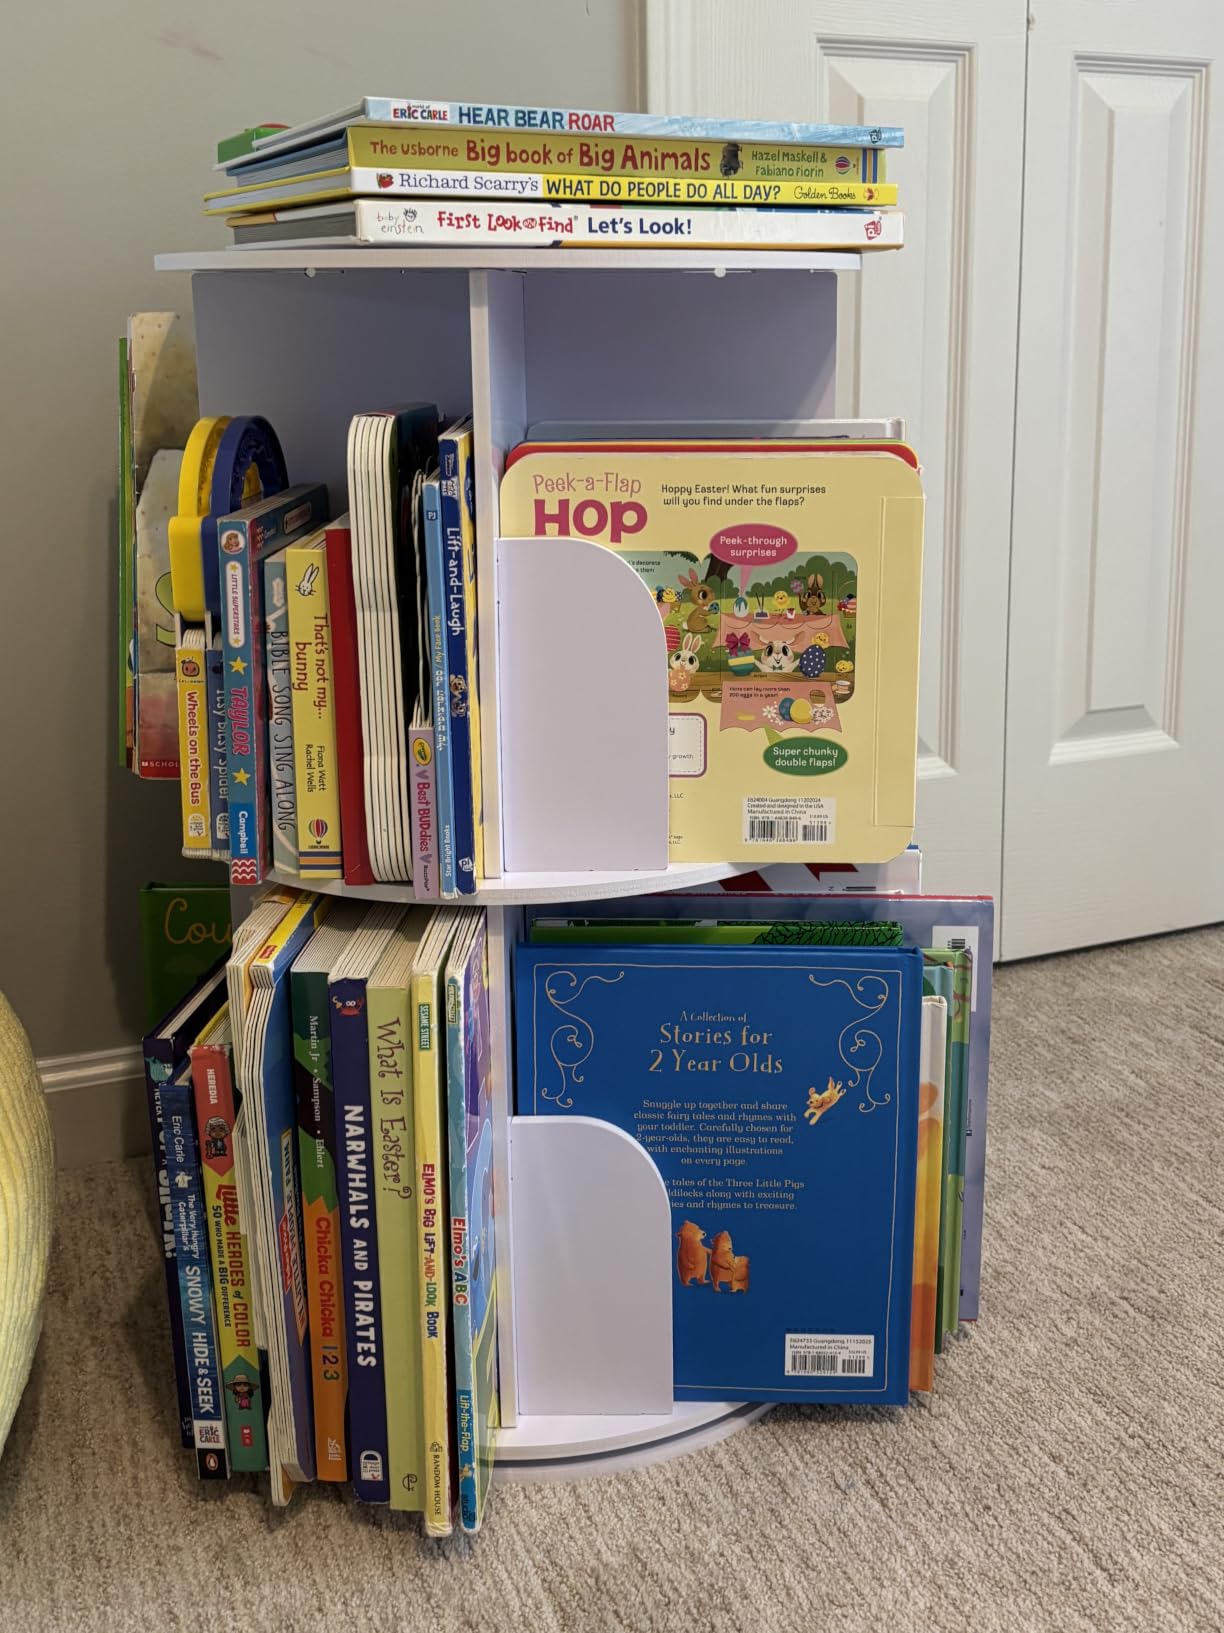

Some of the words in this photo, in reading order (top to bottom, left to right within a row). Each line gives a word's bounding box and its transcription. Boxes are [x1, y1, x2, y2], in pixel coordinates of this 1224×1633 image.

[393, 103, 418, 120] ERIC
[420, 109, 448, 120] CARLE
[459, 106, 510, 126] HEAR
[515, 109, 564, 130] BEAR
[568, 112, 616, 132] ROAR
[369, 139, 397, 155] The
[401, 141, 458, 157] Usborne
[466, 138, 500, 166] Big
[506, 142, 552, 165] book
[556, 148, 574, 164] of
[580, 142, 615, 172] Big
[620, 144, 711, 172] Animals
[752, 150, 780, 162] Hazel
[782, 150, 818, 163] Maskell
[820, 153, 828, 164] &
[755, 164, 794, 177] Fabiano
[796, 166, 824, 178] Fiorin
[398, 172, 470, 190] Richard
[474, 176, 538, 194] Scarry's
[546, 178, 594, 196] WHAT
[600, 180, 622, 196] DO
[628, 181, 681, 198] PEOPLE
[686, 183, 708, 198] DO
[713, 183, 738, 200] ALL
[744, 184, 781, 201] DAY?
[794, 186, 826, 200] Golden
[828, 187, 856, 200] Books
[437, 210, 480, 230] First
[488, 213, 522, 232] Look
[588, 216, 632, 234] Let's
[640, 217, 692, 234] Look!
[532, 472, 642, 498] Peek-a-Flap
[662, 484, 692, 496] Hoppy
[694, 484, 730, 494] Easter!
[732, 484, 758, 494] What
[760, 484, 778, 494] fun
[780, 484, 826, 496] surprises
[663, 496, 680, 506] will
[682, 498, 700, 508] you
[703, 496, 722, 506] find
[724, 496, 754, 506] under
[756, 496, 773, 506] the
[775, 496, 805, 508] flaps?
[534, 498, 648, 544] HOP
[720, 536, 788, 548] Peek-through
[730, 548, 777, 558] surprises
[231, 573, 239, 595] LITTLE
[446, 527, 464, 636] Lift-and-Laugh
[232, 596, 241, 635] SUPERSTARS
[313, 613, 329, 655] That's
[270, 631, 290, 675] BIBLE
[435, 649, 446, 662] My
[292, 642, 312, 691] bunny
[315, 658, 330, 683] not
[186, 691, 199, 736] Wheels
[272, 685, 292, 726] SONG
[314, 687, 329, 720] my...
[227, 687, 250, 756] TAYLOR
[188, 739, 201, 755] on
[274, 734, 293, 772] SING
[305, 743, 316, 770] Rachel
[317, 745, 327, 768] Fiona
[773, 746, 800, 758] Super
[803, 747, 838, 758] chunky
[150, 760, 179, 768] SCHOL
[189, 757, 201, 779] the
[776, 758, 806, 768] double
[808, 758, 836, 768] flaps!
[190, 782, 202, 805] Bus
[306, 772, 317, 793] Wells
[317, 770, 327, 792] Watt
[417, 782, 430, 805] Best
[276, 780, 295, 831] ALONG
[238, 811, 248, 854] Campbell
[418, 808, 431, 852] BUDdies
[444, 844, 453, 863] Bright
[444, 864, 452, 877] Star
[420, 1005, 429, 1028] SESAME
[680, 1010, 688, 1022] A
[690, 1011, 736, 1022] Collection
[738, 1012, 748, 1023] of
[309, 1015, 320, 1049] Martin
[420, 1029, 429, 1049] STREET
[660, 1022, 732, 1045] Stories
[741, 1026, 774, 1046] for
[310, 1051, 321, 1062] Jr
[376, 1016, 406, 1079] What
[648, 1049, 662, 1072] 2
[672, 1048, 722, 1072] Year
[730, 1052, 784, 1074] Olds
[206, 1068, 218, 1104] HEREDIA
[380, 1089, 404, 1105] Is
[311, 1077, 323, 1122] Sampson
[642, 1100, 682, 1110] Snuggle
[684, 1102, 696, 1110] up
[698, 1100, 738, 1110] together
[740, 1101, 759, 1110] and
[761, 1101, 788, 1110] share
[172, 1115, 184, 1135] Eric
[634, 1110, 664, 1119] classic
[668, 1111, 690, 1120] fairy
[692, 1112, 716, 1120] tales
[718, 1112, 736, 1120] and
[738, 1112, 773, 1122] rhymes
[776, 1112, 797, 1122] with
[173, 1137, 186, 1163] Carle
[315, 1139, 325, 1169] Ehlert
[380, 1116, 412, 1201] Easter?
[343, 1104, 370, 1229] NARWHALS
[187, 1194, 196, 1209] The
[212, 1205, 225, 1218] 50
[215, 1184, 240, 1227] Little
[178, 1202, 190, 1251] Caterpillar's
[187, 1210, 198, 1229] Very
[214, 1220, 223, 1237] WHO
[189, 1230, 200, 1259] Hungry
[216, 1239, 225, 1259] MADE
[316, 1216, 332, 1274] Chicka
[352, 1238, 369, 1271] AND
[452, 1217, 467, 1268] Elmo's
[226, 1231, 245, 1287] HEROES
[218, 1267, 229, 1285] BIG
[454, 1271, 468, 1305] ABC
[185, 1265, 206, 1325] SNOWY
[220, 1286, 232, 1327] DIFFERENCE
[233, 1290, 243, 1300] of
[318, 1280, 336, 1338] Chicka
[233, 1302, 251, 1347] COLOR
[353, 1280, 377, 1368] PIRATES
[192, 1332, 209, 1366] HIDE
[196, 1377, 215, 1413] SEEK
[459, 1395, 471, 1453] Lift-the-Flap
